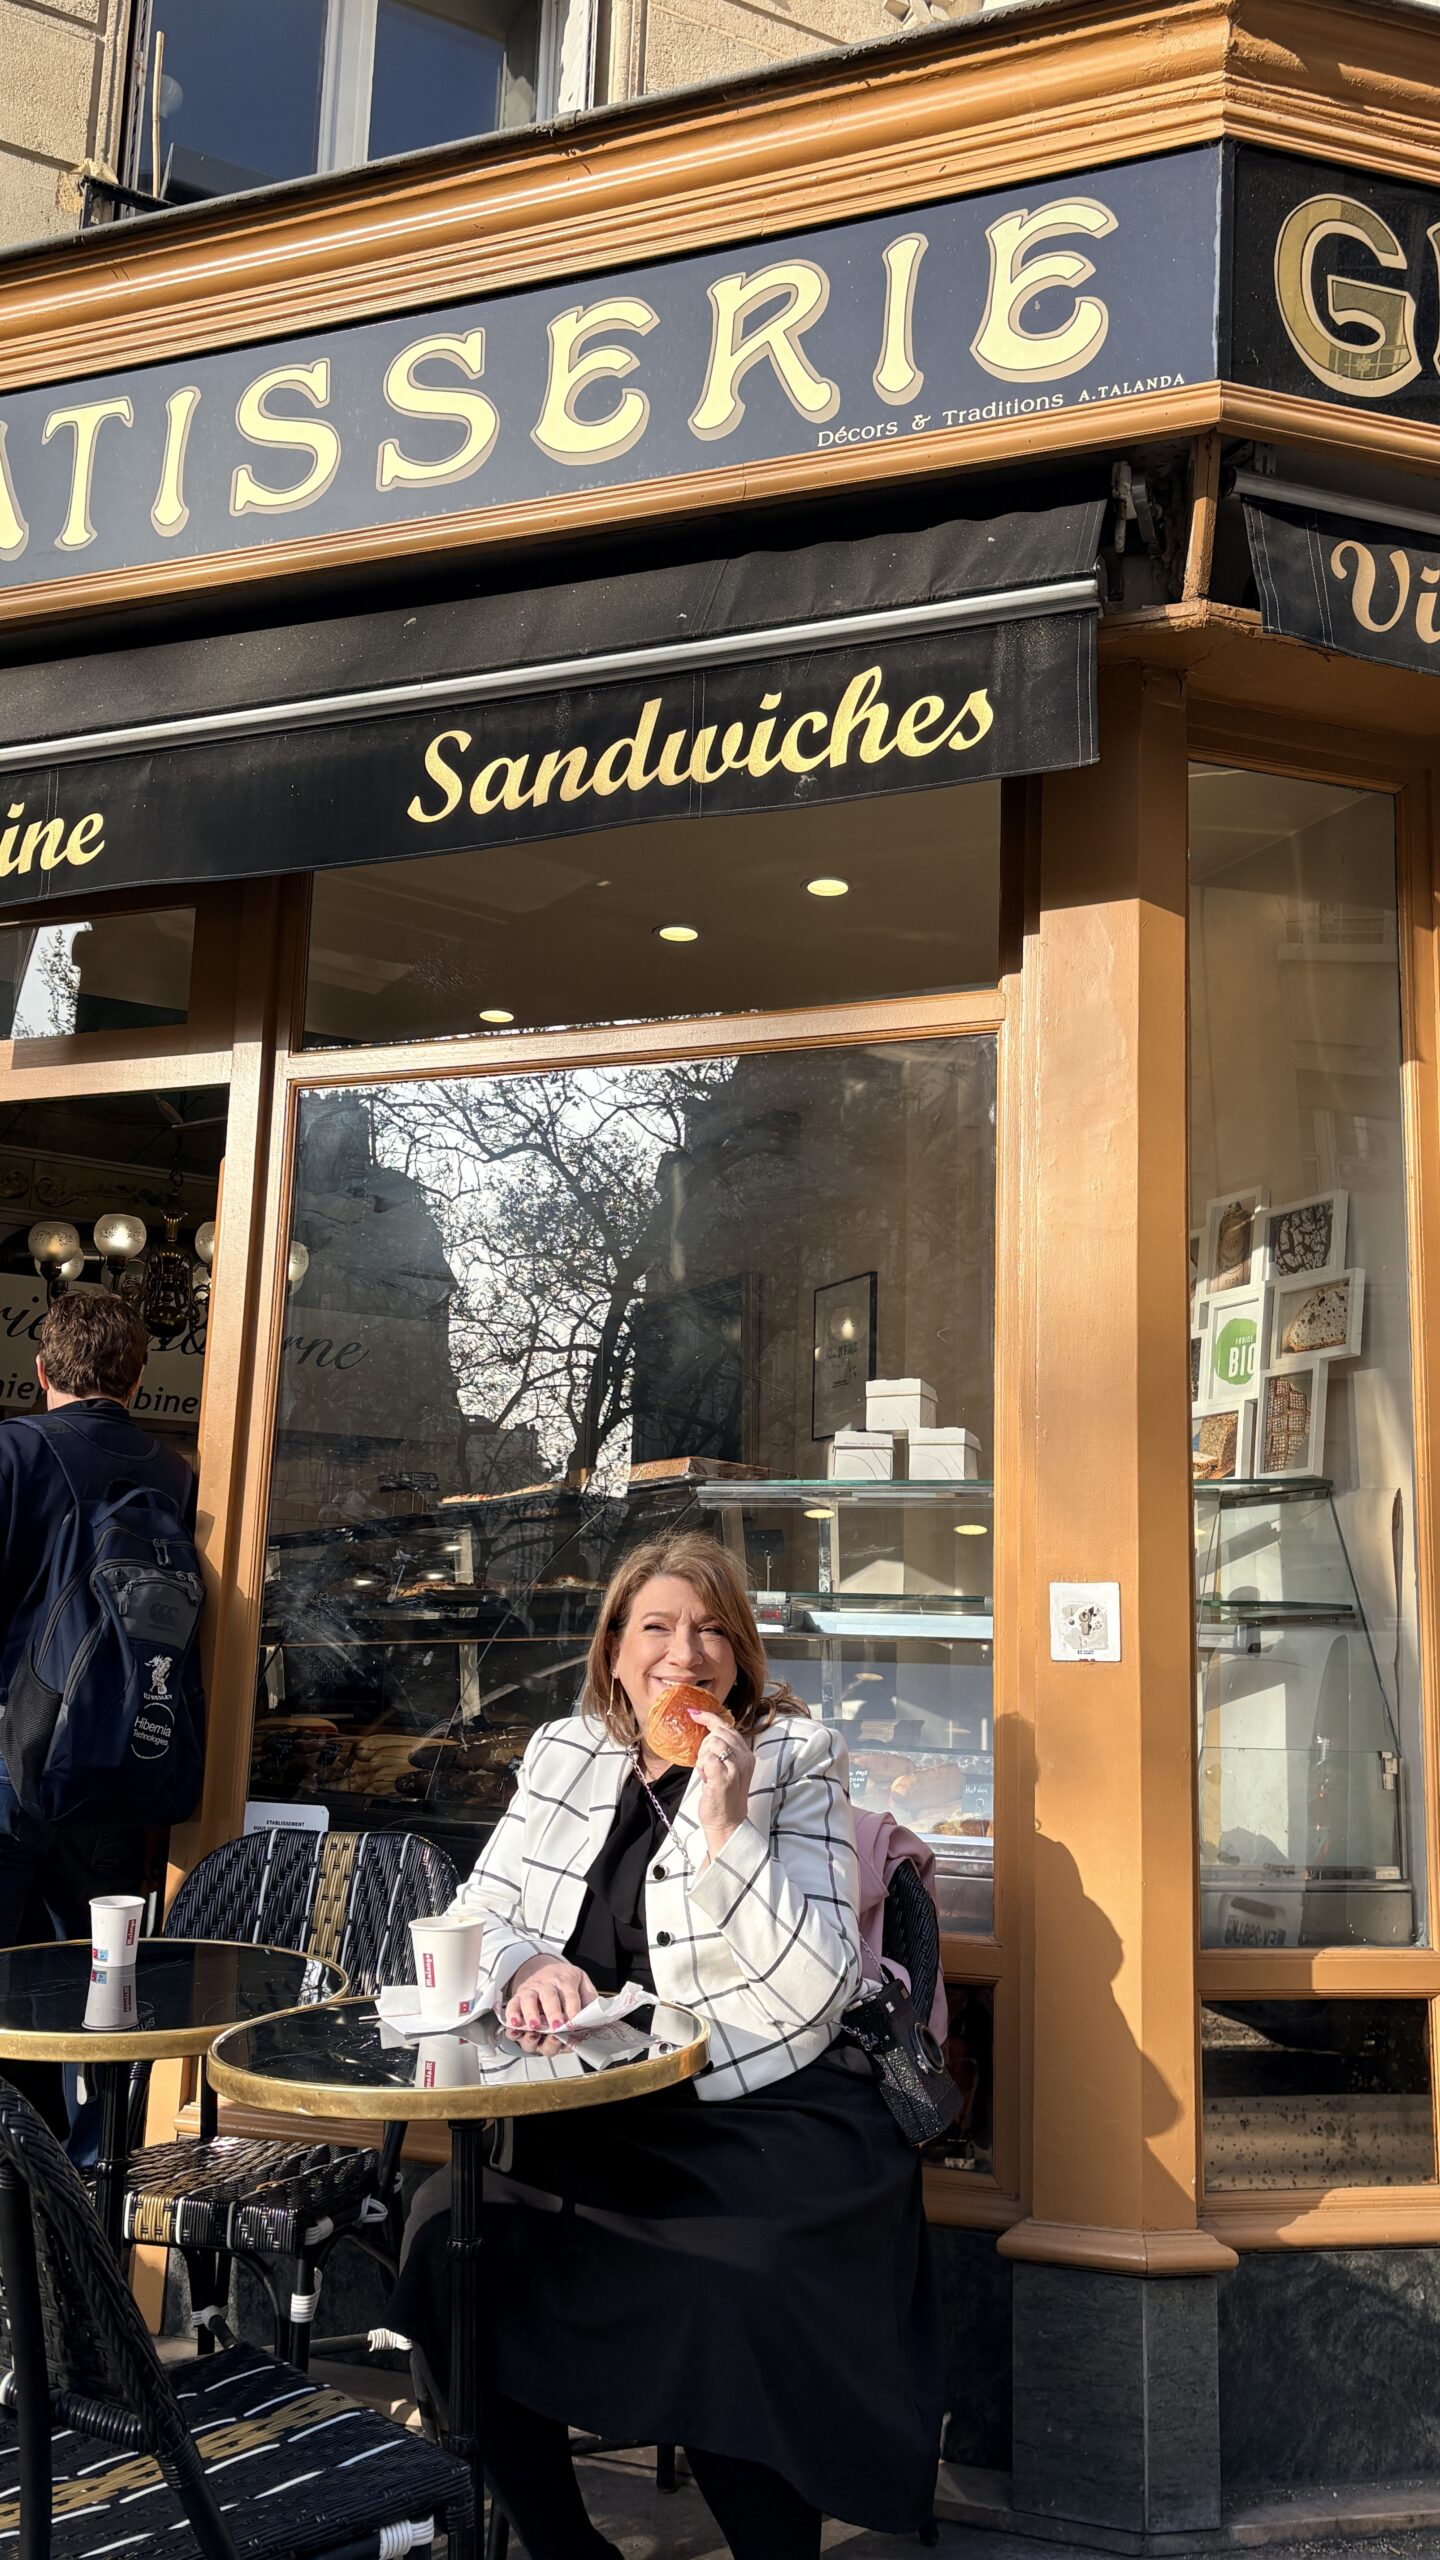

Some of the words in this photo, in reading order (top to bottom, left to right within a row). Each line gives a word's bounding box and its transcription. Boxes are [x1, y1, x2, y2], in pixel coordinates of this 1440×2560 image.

[1273, 192, 1440, 398] G
[817, 420, 898, 448] Décors
[911, 414, 932, 431] &
[942, 393, 1064, 427] Traditions
[407, 665, 994, 823] Sandwiches
[1228, 1343, 1257, 1378] BIO
[133, 1729, 169, 1746] Technologies
[134, 1716, 172, 1737] Hibernia
